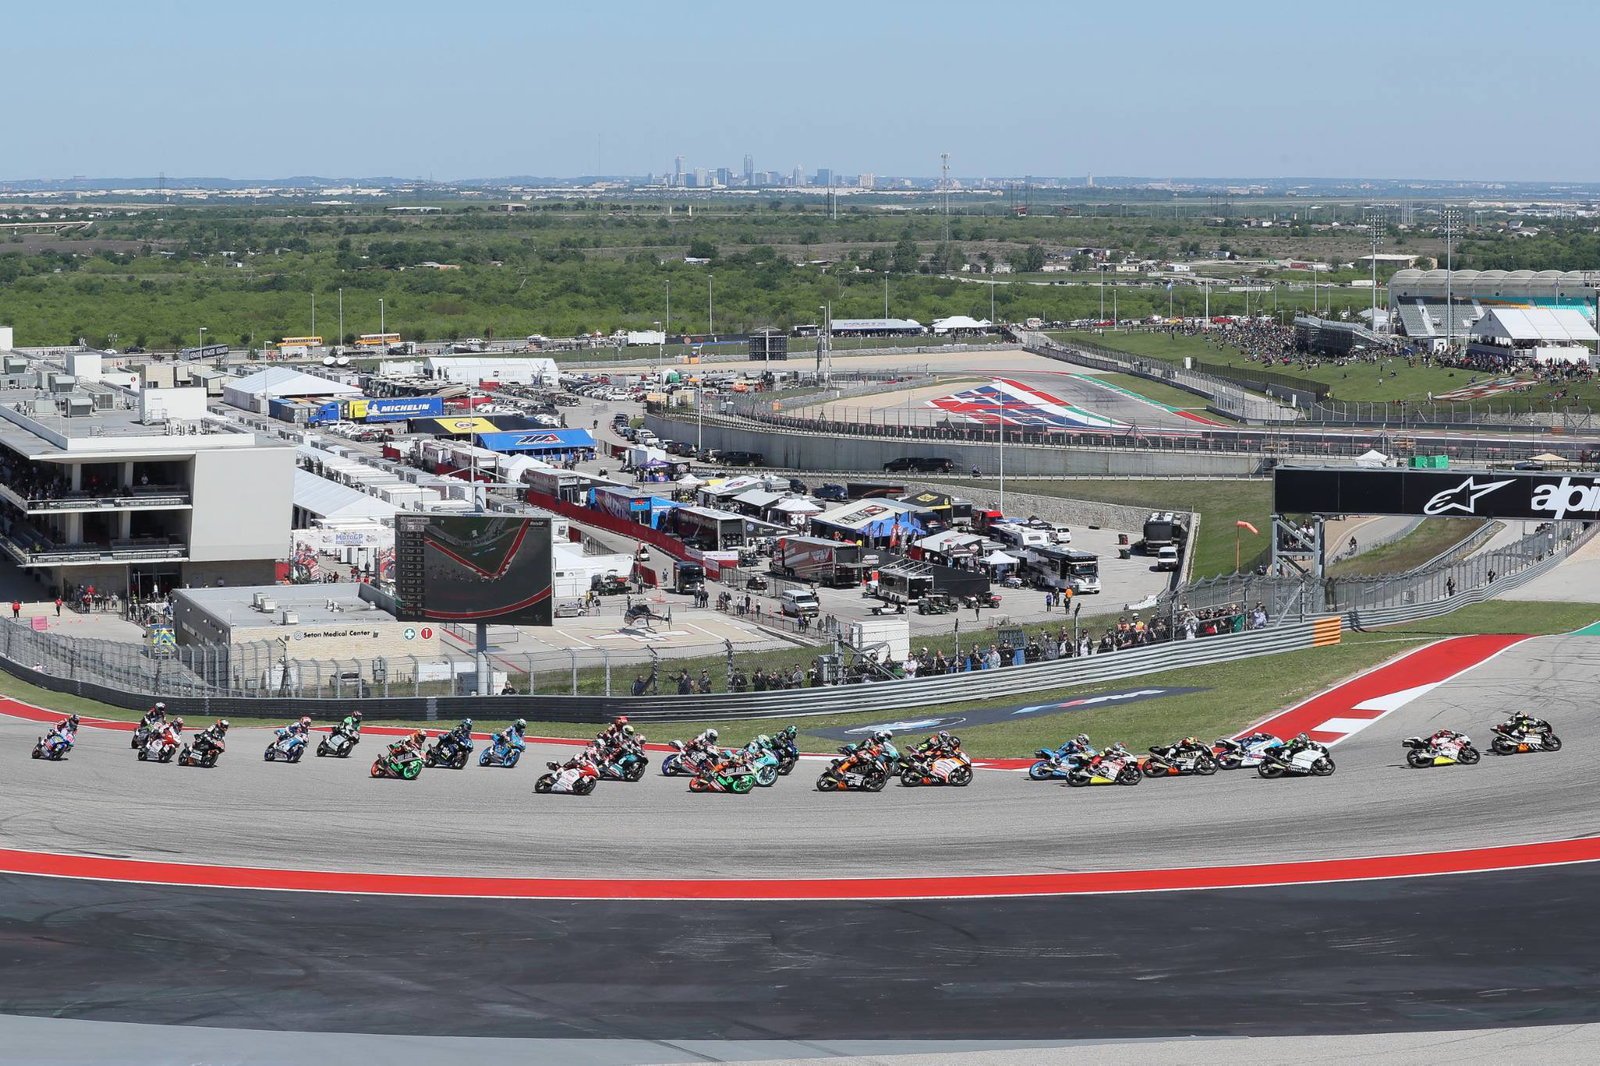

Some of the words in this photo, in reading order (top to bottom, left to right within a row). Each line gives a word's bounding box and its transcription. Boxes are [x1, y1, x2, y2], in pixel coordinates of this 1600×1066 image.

[381, 403, 430, 412] MICHELIN
[790, 513, 805, 525] 33
[323, 630, 348, 638] Medical
